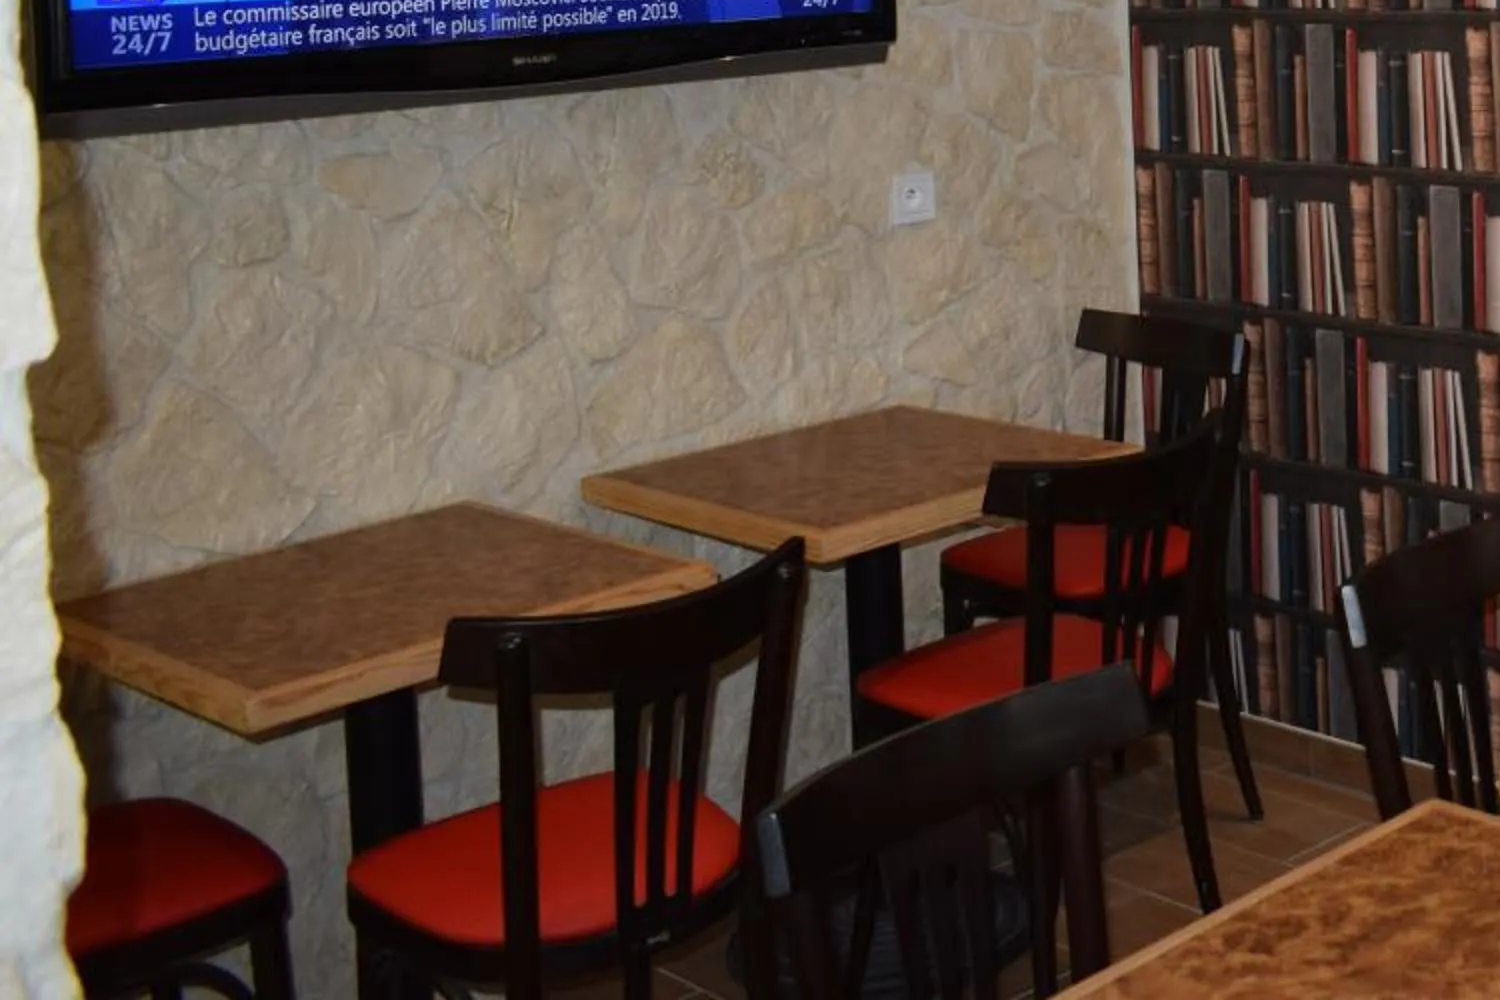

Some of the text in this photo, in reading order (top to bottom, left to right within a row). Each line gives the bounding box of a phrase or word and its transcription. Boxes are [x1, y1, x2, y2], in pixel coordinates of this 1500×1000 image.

[111, 13, 173, 33] NEWS
[194, 7, 217, 27] Le
[223, 0, 344, 24] commissaire
[195, 26, 303, 55] budgétaire
[308, 21, 380, 47] français
[384, 19, 418, 38] soit
[422, 16, 447, 36] "le
[451, 14, 487, 38] plus
[491, 11, 538, 31] limité
[617, 8, 637, 23] en
[641, 1, 682, 21] 2019.
[111, 31, 172, 56] 24/7
